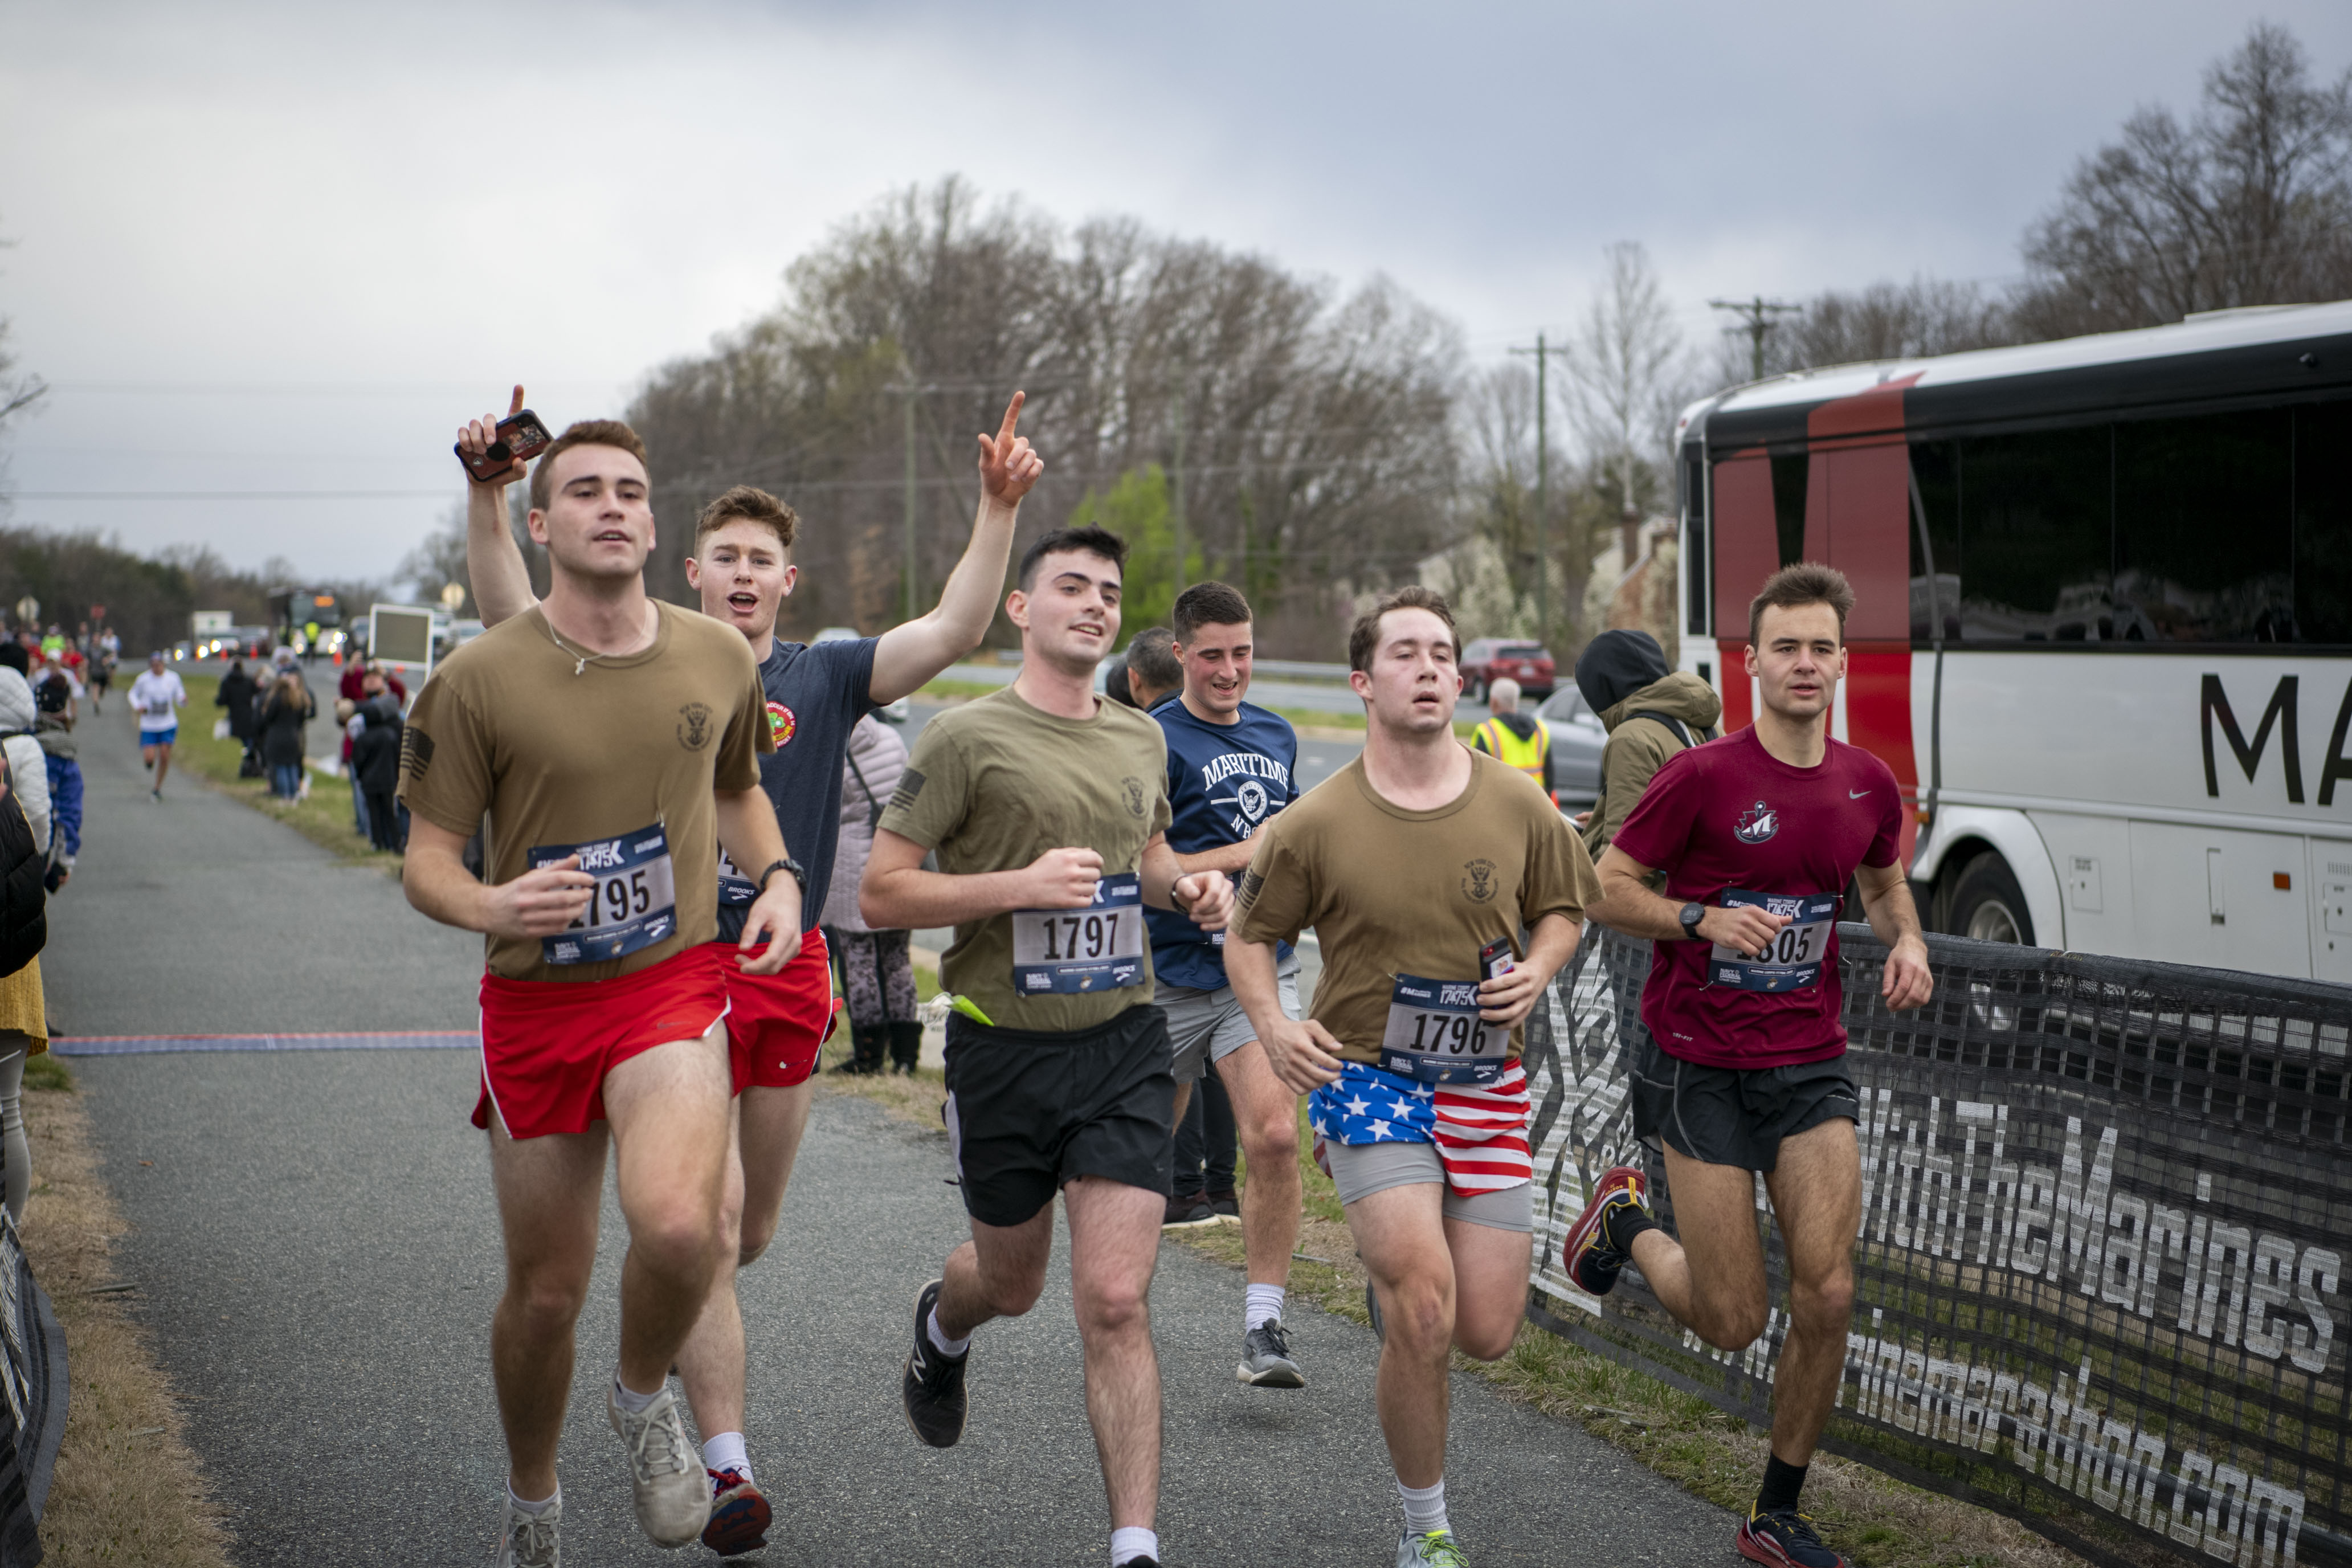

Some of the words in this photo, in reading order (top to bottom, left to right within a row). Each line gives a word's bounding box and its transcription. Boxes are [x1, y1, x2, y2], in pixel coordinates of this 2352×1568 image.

[569, 869, 650, 928] 795
[727, 886, 755, 895] BROOKS
[1043, 913, 1118, 959] 1797
[1737, 927, 1813, 964] 05
[1796, 969, 1816, 977] BROOKS
[1410, 1013, 1487, 1055] 1796
